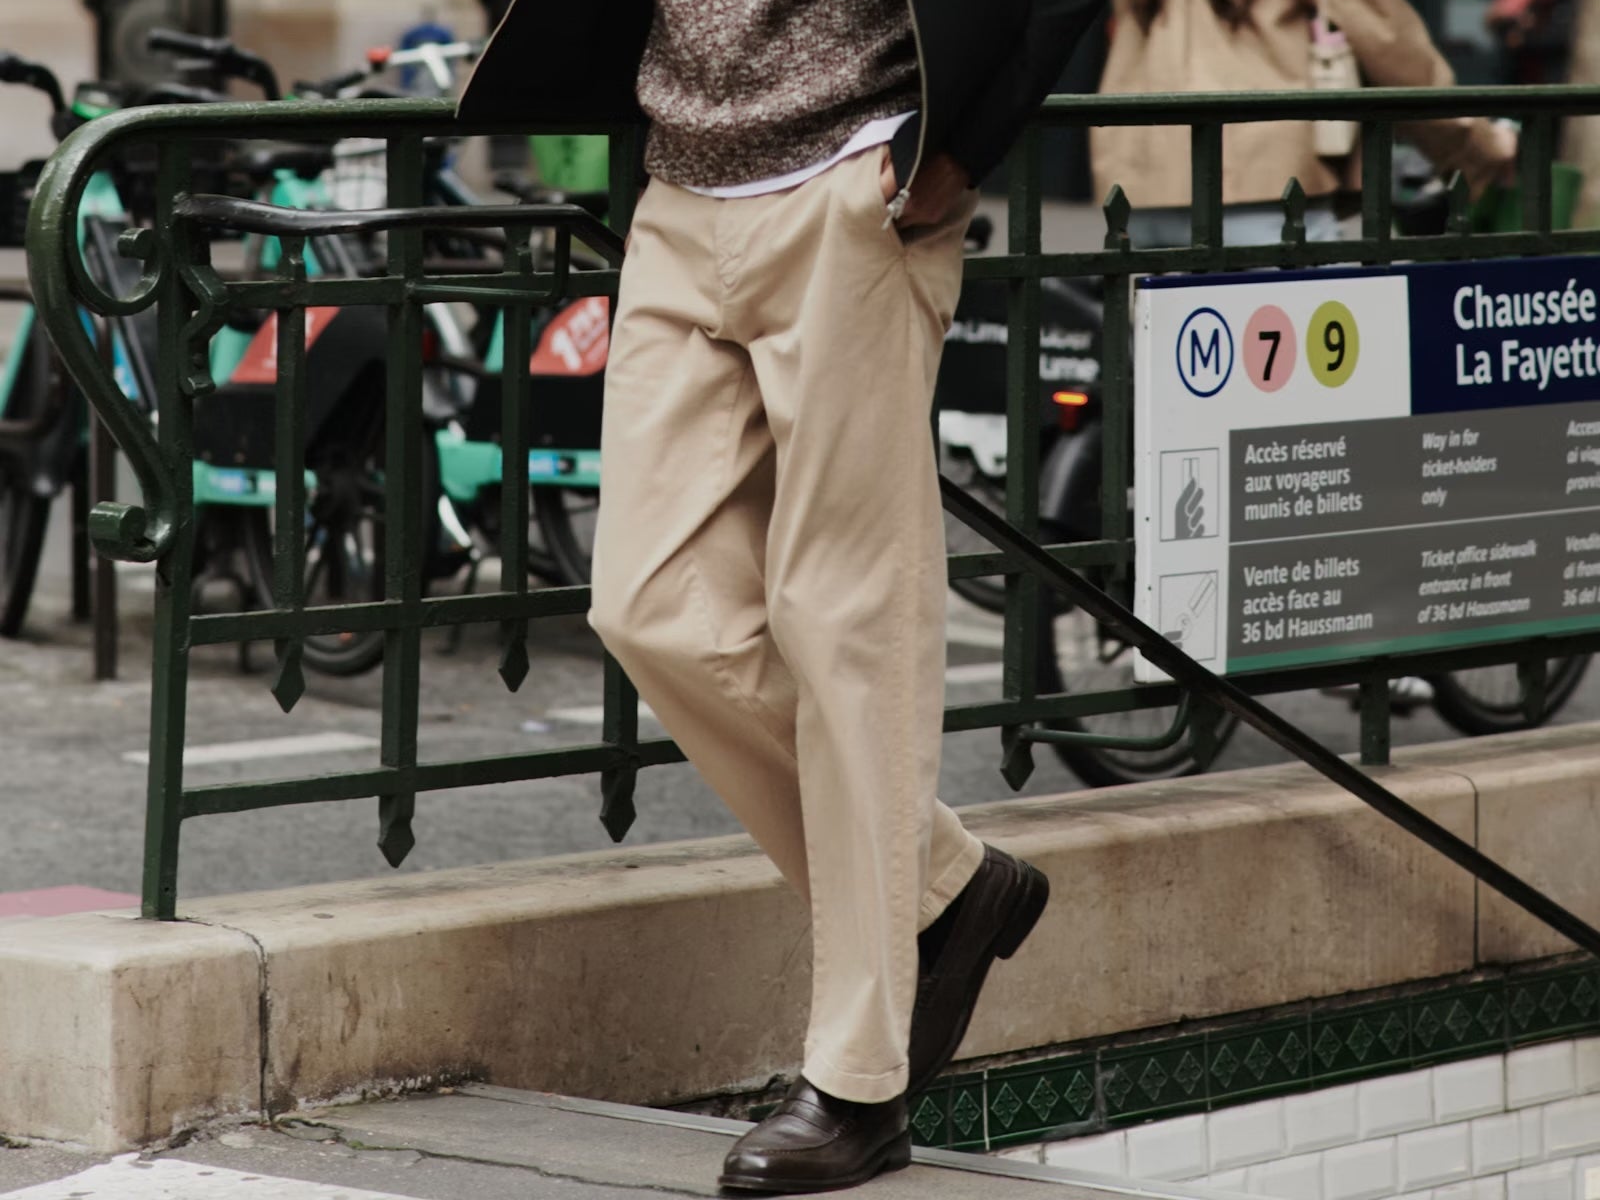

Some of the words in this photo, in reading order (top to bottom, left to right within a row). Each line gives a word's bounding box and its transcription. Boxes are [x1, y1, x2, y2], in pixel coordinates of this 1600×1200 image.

[1453, 278, 1596, 330] Chaussée
[1190, 327, 1220, 377] M
[1258, 330, 1281, 381] 7
[1323, 320, 1346, 372] 9
[1456, 343, 1493, 385] La
[1501, 337, 1600, 391] Fayett
[1244, 441, 1289, 464] Accès
[1292, 435, 1347, 460] réservé
[1422, 432, 1448, 452] Way
[1449, 430, 1461, 447] in
[1462, 428, 1480, 446] for
[1422, 455, 1497, 477] ticket-holders
[1245, 475, 1273, 492] aux
[1275, 468, 1351, 493] voyageurs
[1245, 497, 1291, 520] munis
[1294, 495, 1313, 516] de
[1316, 491, 1363, 514] billets
[1421, 487, 1448, 507] only
[1421, 549, 1456, 568] Ticket
[1456, 545, 1489, 564] office
[1244, 565, 1288, 587] Vente
[1292, 561, 1311, 582] de
[1314, 557, 1360, 580] billets
[1419, 579, 1469, 596] entrance
[1470, 573, 1483, 590] in
[1483, 571, 1513, 588] front
[1243, 592, 1284, 615] accès
[1287, 589, 1320, 610] face
[1323, 590, 1342, 606] au
[1417, 605, 1432, 623] of
[1431, 604, 1448, 622] 36
[1449, 602, 1466, 620] bd
[1241, 622, 1261, 644] 36
[1264, 618, 1284, 641] bd
[1287, 613, 1373, 638] Haussmann
